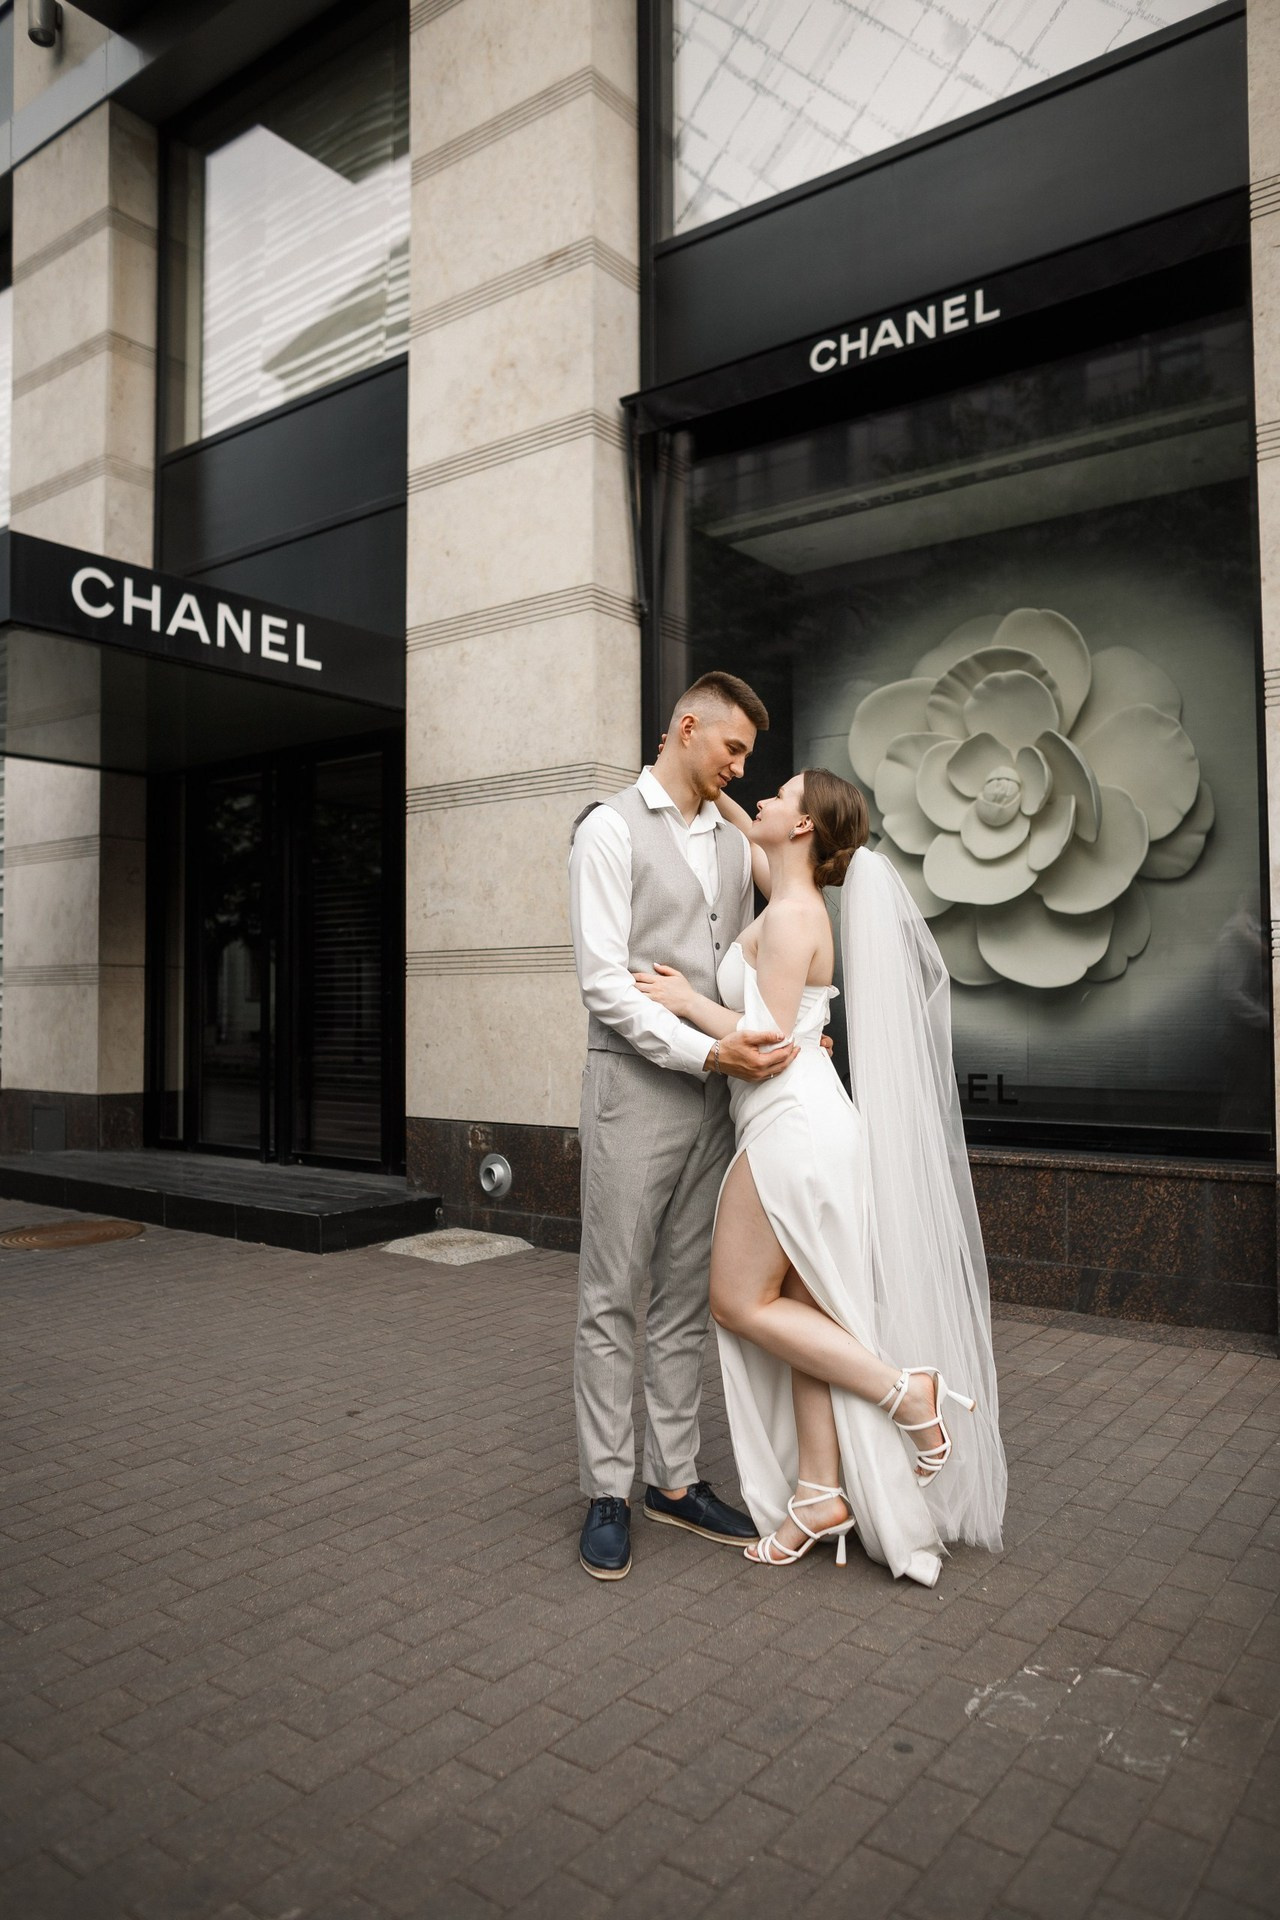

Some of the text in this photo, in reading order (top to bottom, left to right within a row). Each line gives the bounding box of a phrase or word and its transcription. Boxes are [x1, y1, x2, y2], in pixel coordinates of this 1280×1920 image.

[809, 289, 1001, 373] CHANEL
[71, 567, 322, 671] CHANEL
[955, 1073, 1018, 1106] EL
